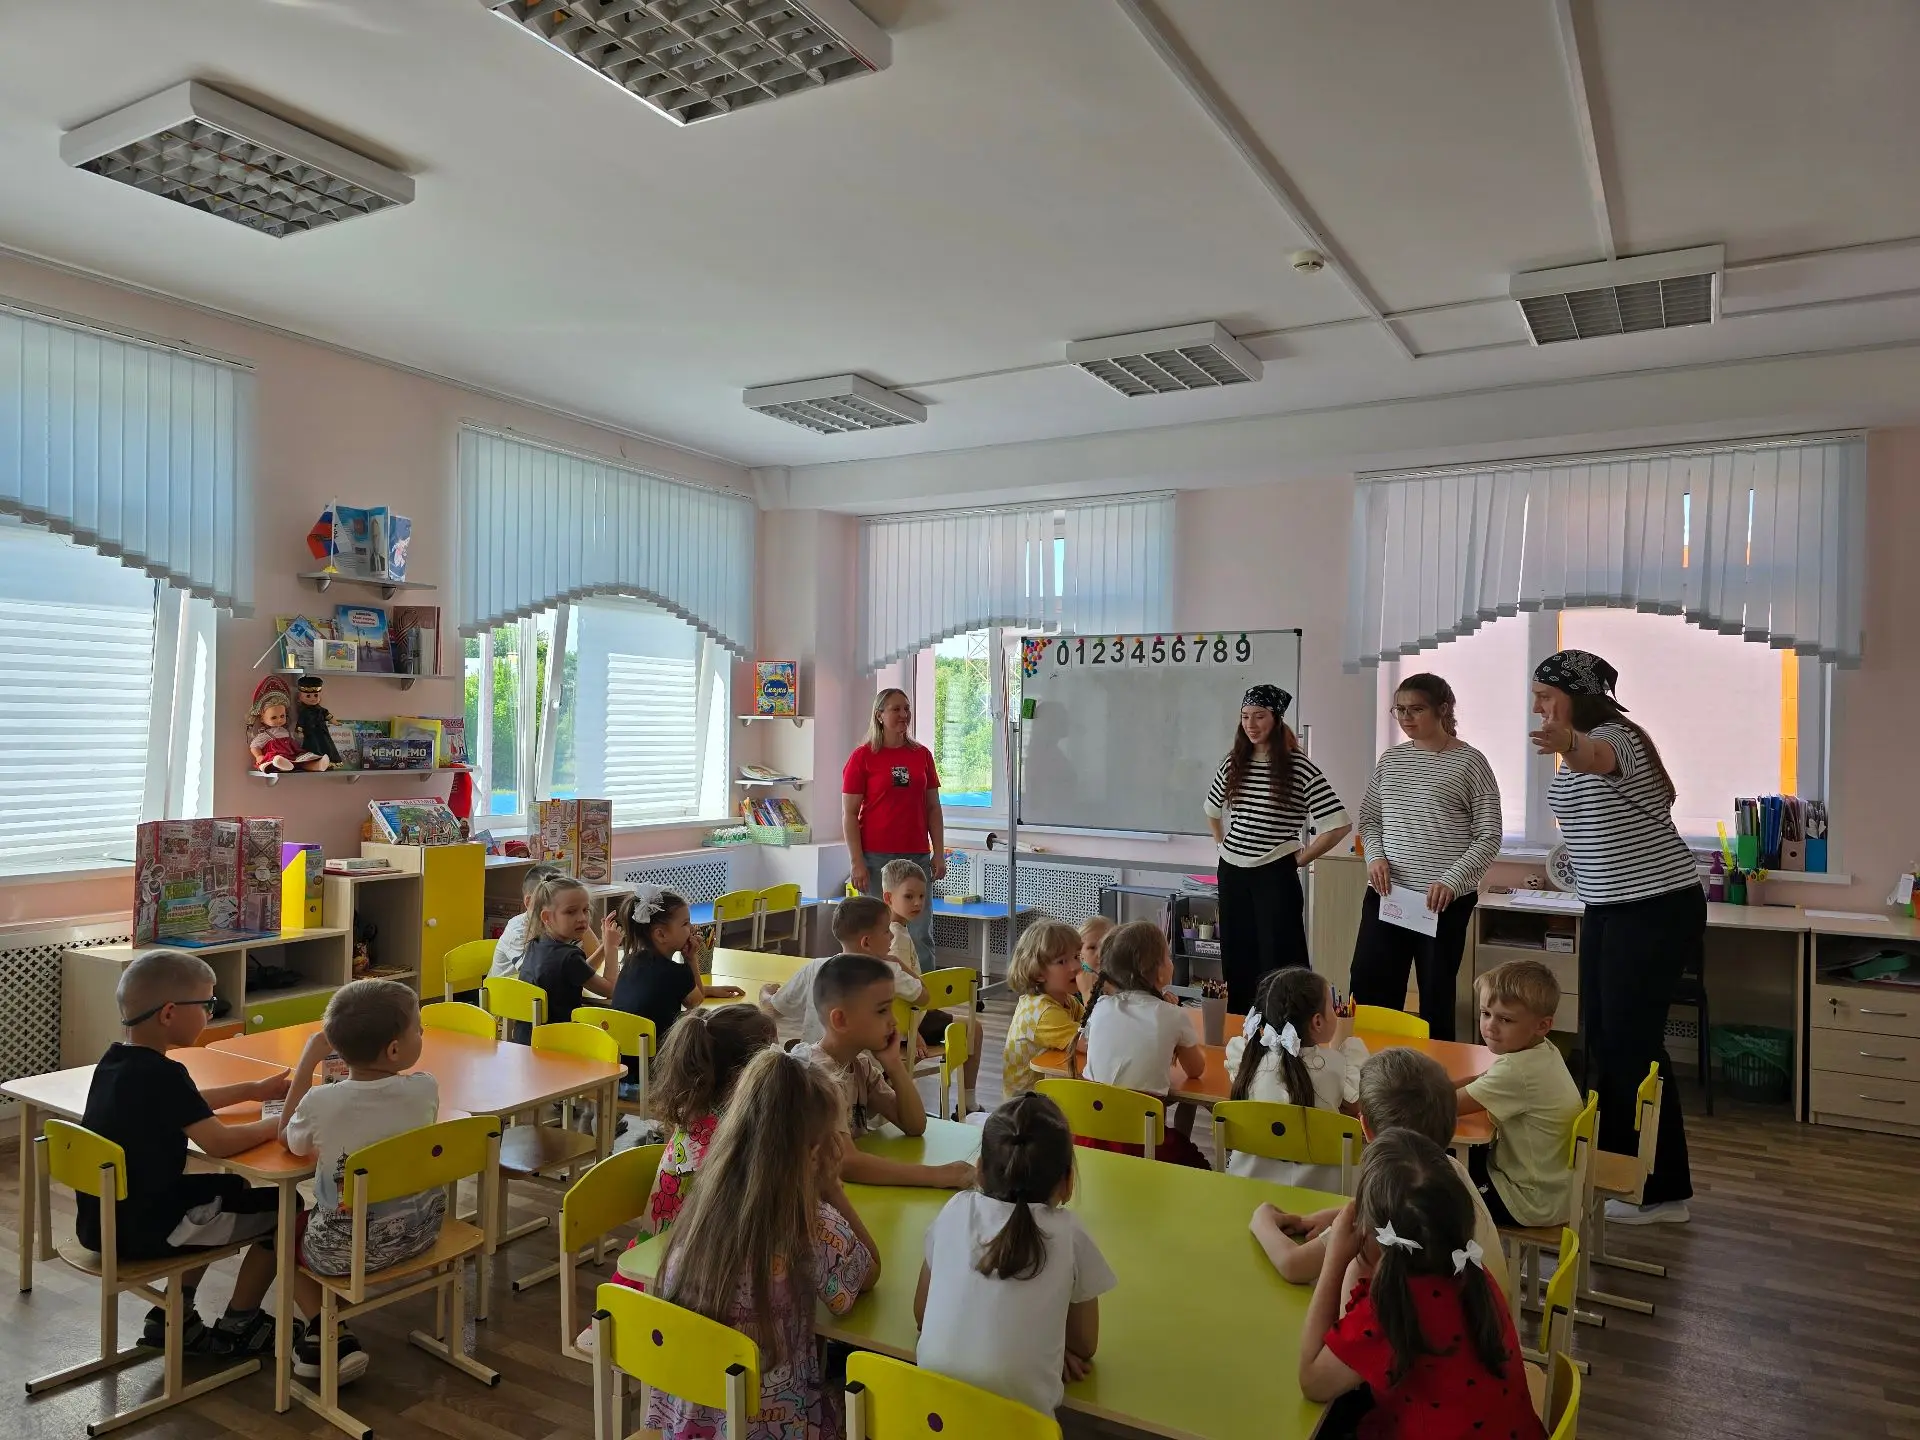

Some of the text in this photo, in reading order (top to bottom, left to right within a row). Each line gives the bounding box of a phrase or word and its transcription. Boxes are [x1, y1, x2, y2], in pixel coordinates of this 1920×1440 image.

[1057, 639, 1251, 666] 0 1 2 3 4 5 6 7 8 9
[408, 748, 427, 757] ЕМО
